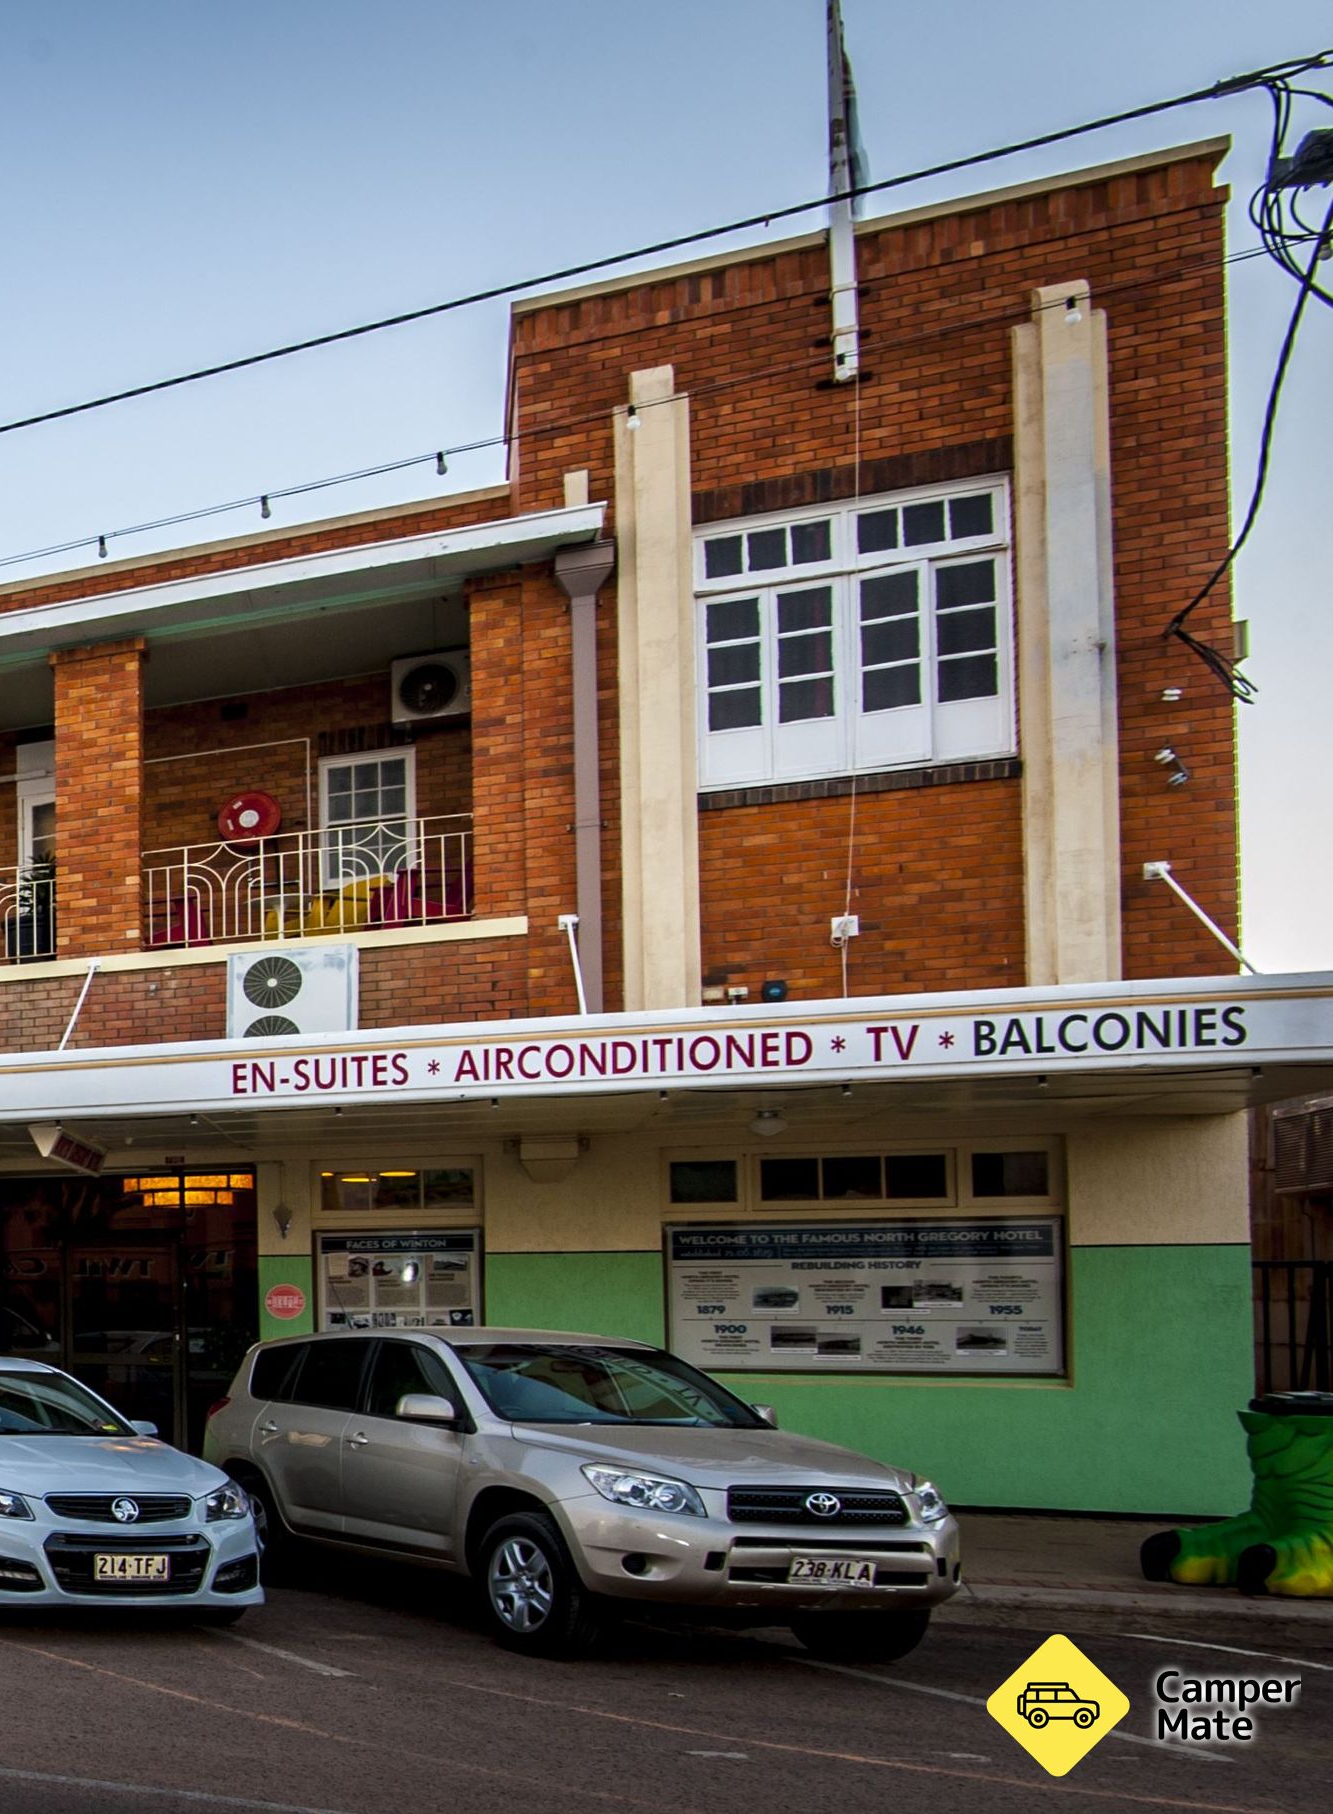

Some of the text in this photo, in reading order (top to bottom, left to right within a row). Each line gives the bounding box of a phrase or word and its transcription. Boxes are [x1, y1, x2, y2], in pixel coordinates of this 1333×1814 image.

[231, 1005, 1247, 1095] EN-SUITES AIRCONDITIONED TV BALCONIES
[678, 1230, 1043, 1245] WELCOME TO THE FAMOUS NORTH GREGORY HOTEL
[346, 1239, 446, 1249] FACES OF WINTON
[791, 1260, 922, 1270] REBUILDING HISTORY
[696, 1305, 726, 1315] 1879
[825, 1305, 854, 1315] 1915
[989, 1305, 1023, 1315] 1955
[714, 1324, 747, 1334] 1900
[892, 1325, 925, 1334] 1946
